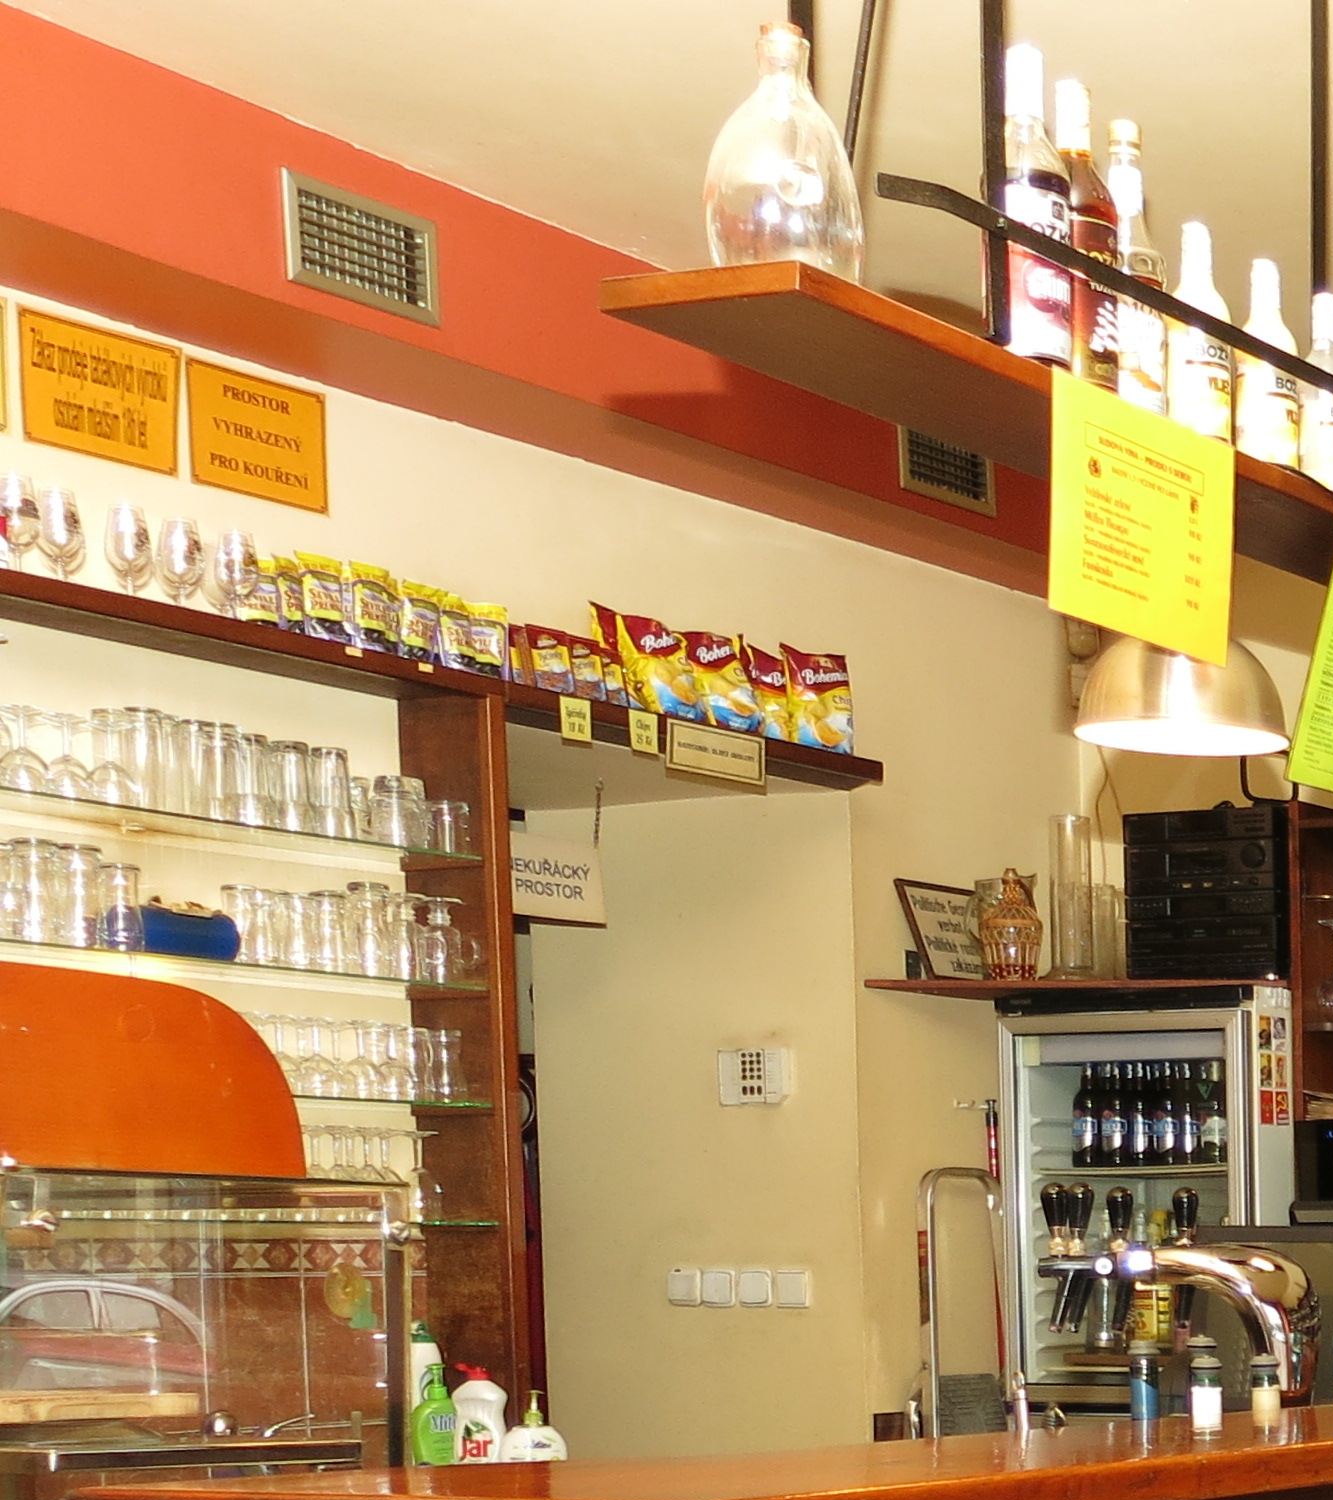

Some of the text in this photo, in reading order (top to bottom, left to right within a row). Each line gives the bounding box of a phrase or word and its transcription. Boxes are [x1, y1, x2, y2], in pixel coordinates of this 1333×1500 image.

[222, 383, 290, 416] PROSTOR
[212, 416, 302, 454] VYHRAZENÝ
[209, 451, 309, 490] PRO KOUŘENÍ
[515, 878, 585, 901] PROSTOR
[460, 1437, 493, 1460] Jar
